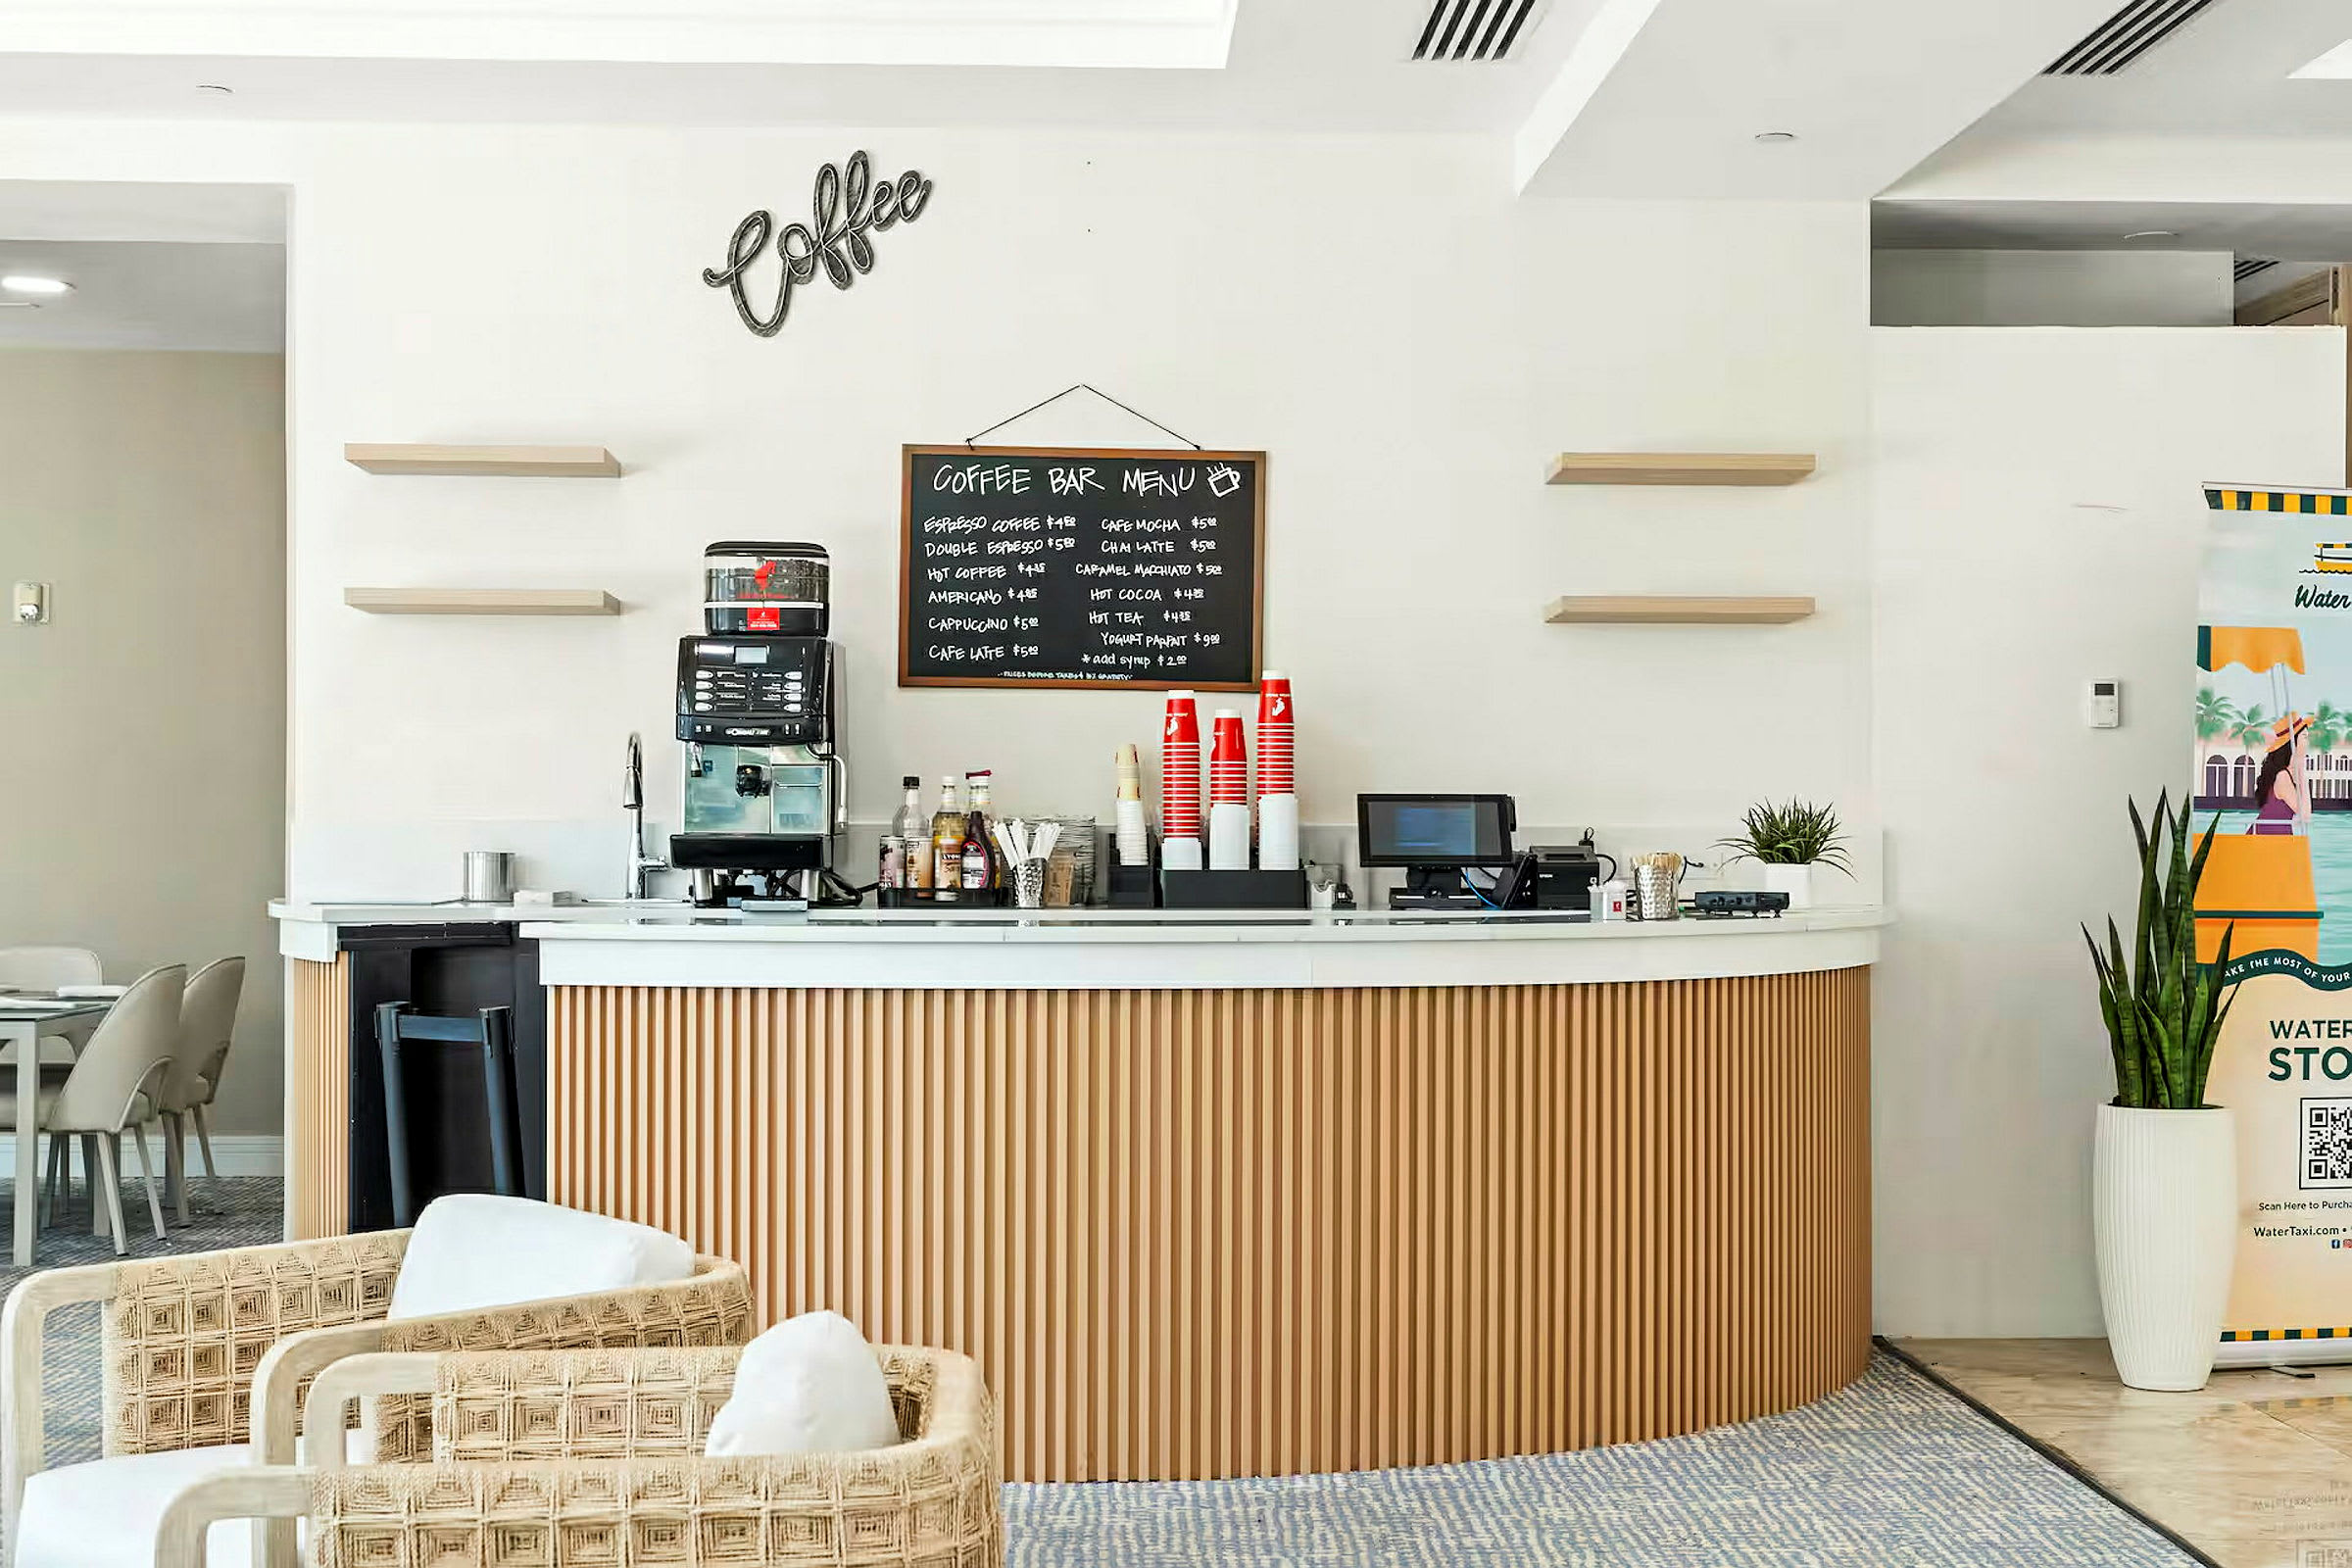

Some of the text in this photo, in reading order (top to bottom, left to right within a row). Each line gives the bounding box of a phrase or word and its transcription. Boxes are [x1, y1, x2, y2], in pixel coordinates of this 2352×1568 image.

[703, 150, 932, 337] Coffee
[933, 464, 1196, 498] COFFEE BAR MENU
[923, 515, 988, 535] ESPRESSO
[991, 516, 1042, 533] COFFEE
[1101, 518, 1134, 533] CAFE
[1135, 518, 1181, 533] MOCHA
[924, 541, 979, 558] DOUBLE
[987, 538, 1044, 556] ESPRESSO
[1101, 539, 1132, 555] CHAI
[1136, 540, 1175, 554] LATTE
[927, 566, 951, 583] HOT
[955, 564, 1007, 581] COFFEE
[1075, 563, 1132, 578] CARAMEL
[1134, 563, 1192, 578] MACCHIATO
[927, 588, 1003, 606] AMERICANO
[1090, 588, 1113, 601] HOT
[1118, 588, 1162, 602] COCOA
[2295, 584, 2352, 609] Water
[928, 617, 1008, 633] CAPPUCCINO
[1089, 610, 1109, 625] HOT
[1114, 611, 1145, 626] TEA
[1100, 631, 1145, 647] YOGURT
[1146, 634, 1188, 650] PARFAIT
[928, 644, 965, 662] CAFE
[969, 645, 1004, 662] LATTE
[1119, 655, 1152, 670] syrup
[2225, 956, 2350, 982] AKE THE MOST OF YOUR
[2268, 1047, 2352, 1081] STO
[2258, 1201, 2281, 1211] Scan
[2254, 1225, 2339, 1237] WaterTaxi.com
